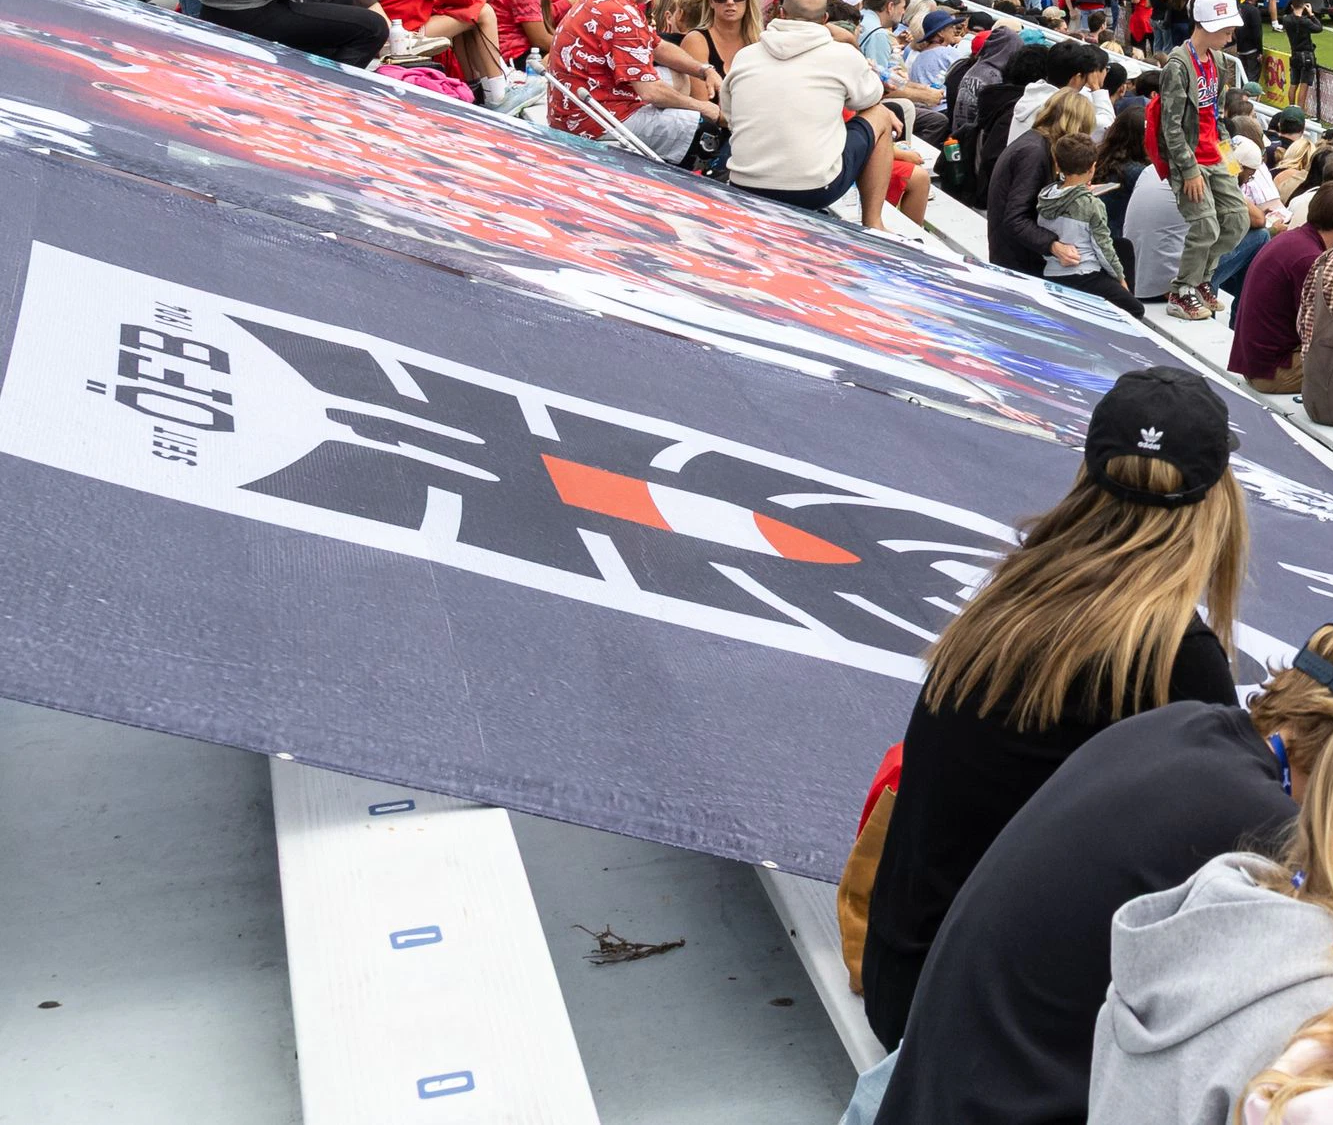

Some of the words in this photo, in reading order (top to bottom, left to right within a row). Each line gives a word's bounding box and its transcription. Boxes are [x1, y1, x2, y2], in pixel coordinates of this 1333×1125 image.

[951, 150, 961, 161] G
[86, 323, 235, 433] ÖFB
[152, 426, 197, 466] SEIT
[1137, 441, 1161, 451] adidas
